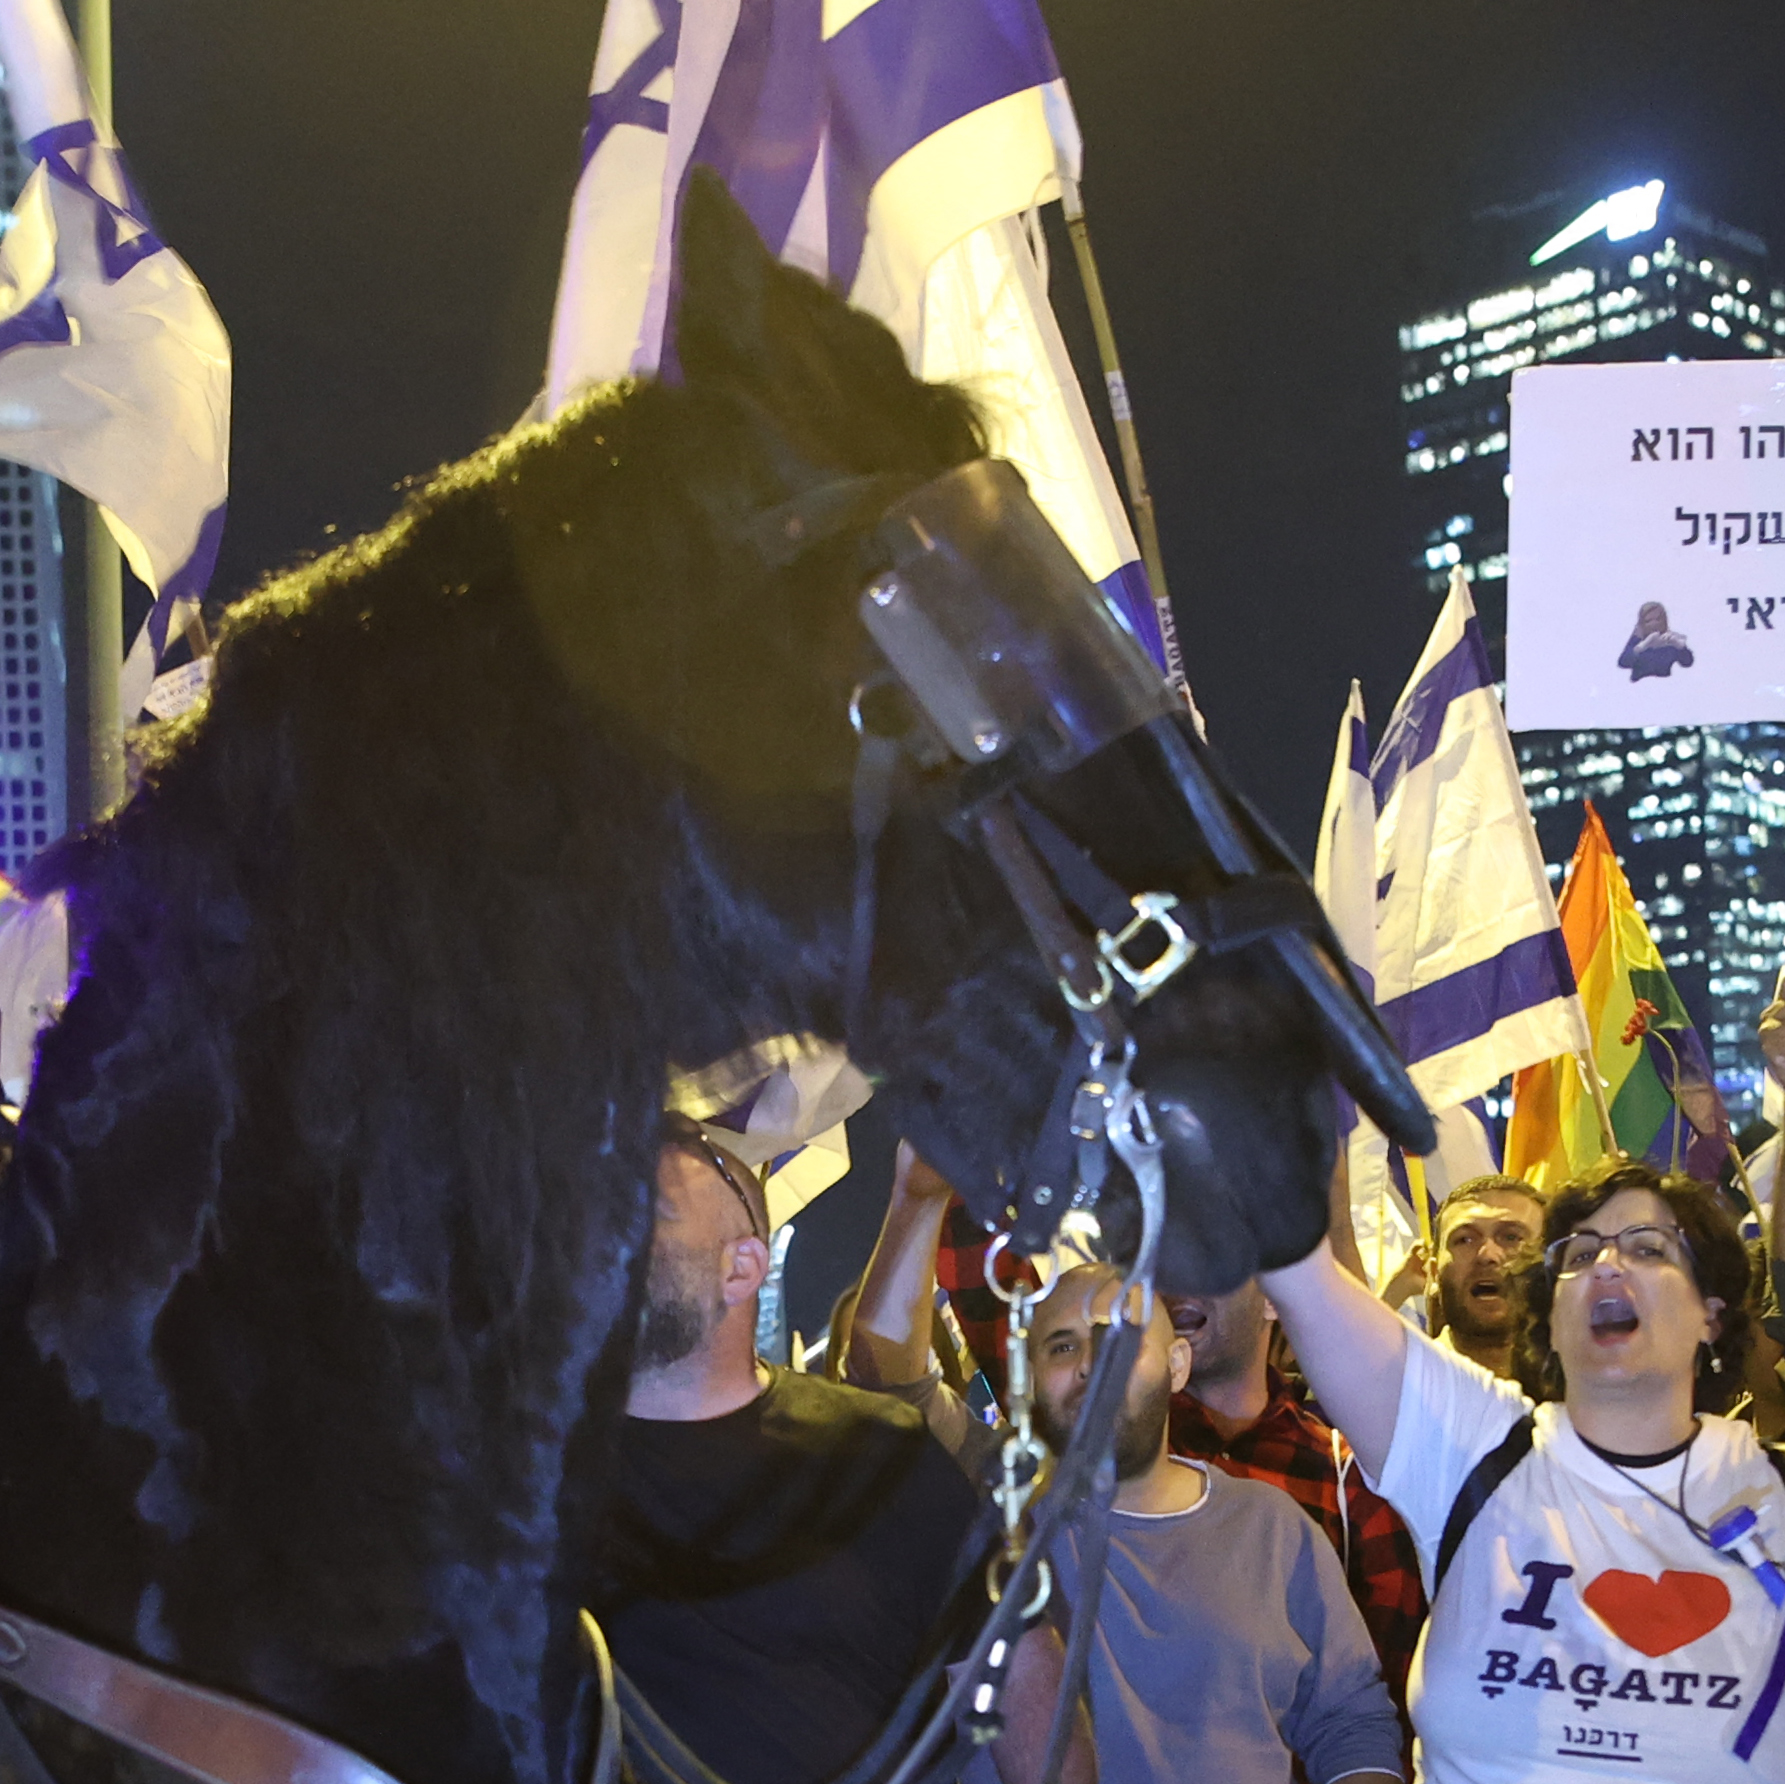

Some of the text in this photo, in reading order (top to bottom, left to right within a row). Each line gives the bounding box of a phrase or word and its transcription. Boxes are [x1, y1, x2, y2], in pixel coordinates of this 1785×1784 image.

[1631, 427, 1715, 462] הוא
[1500, 1560, 1575, 1631] I
[1478, 1649, 1742, 1712] BAGATZ
[1562, 1724, 1639, 1751] דרכנו
